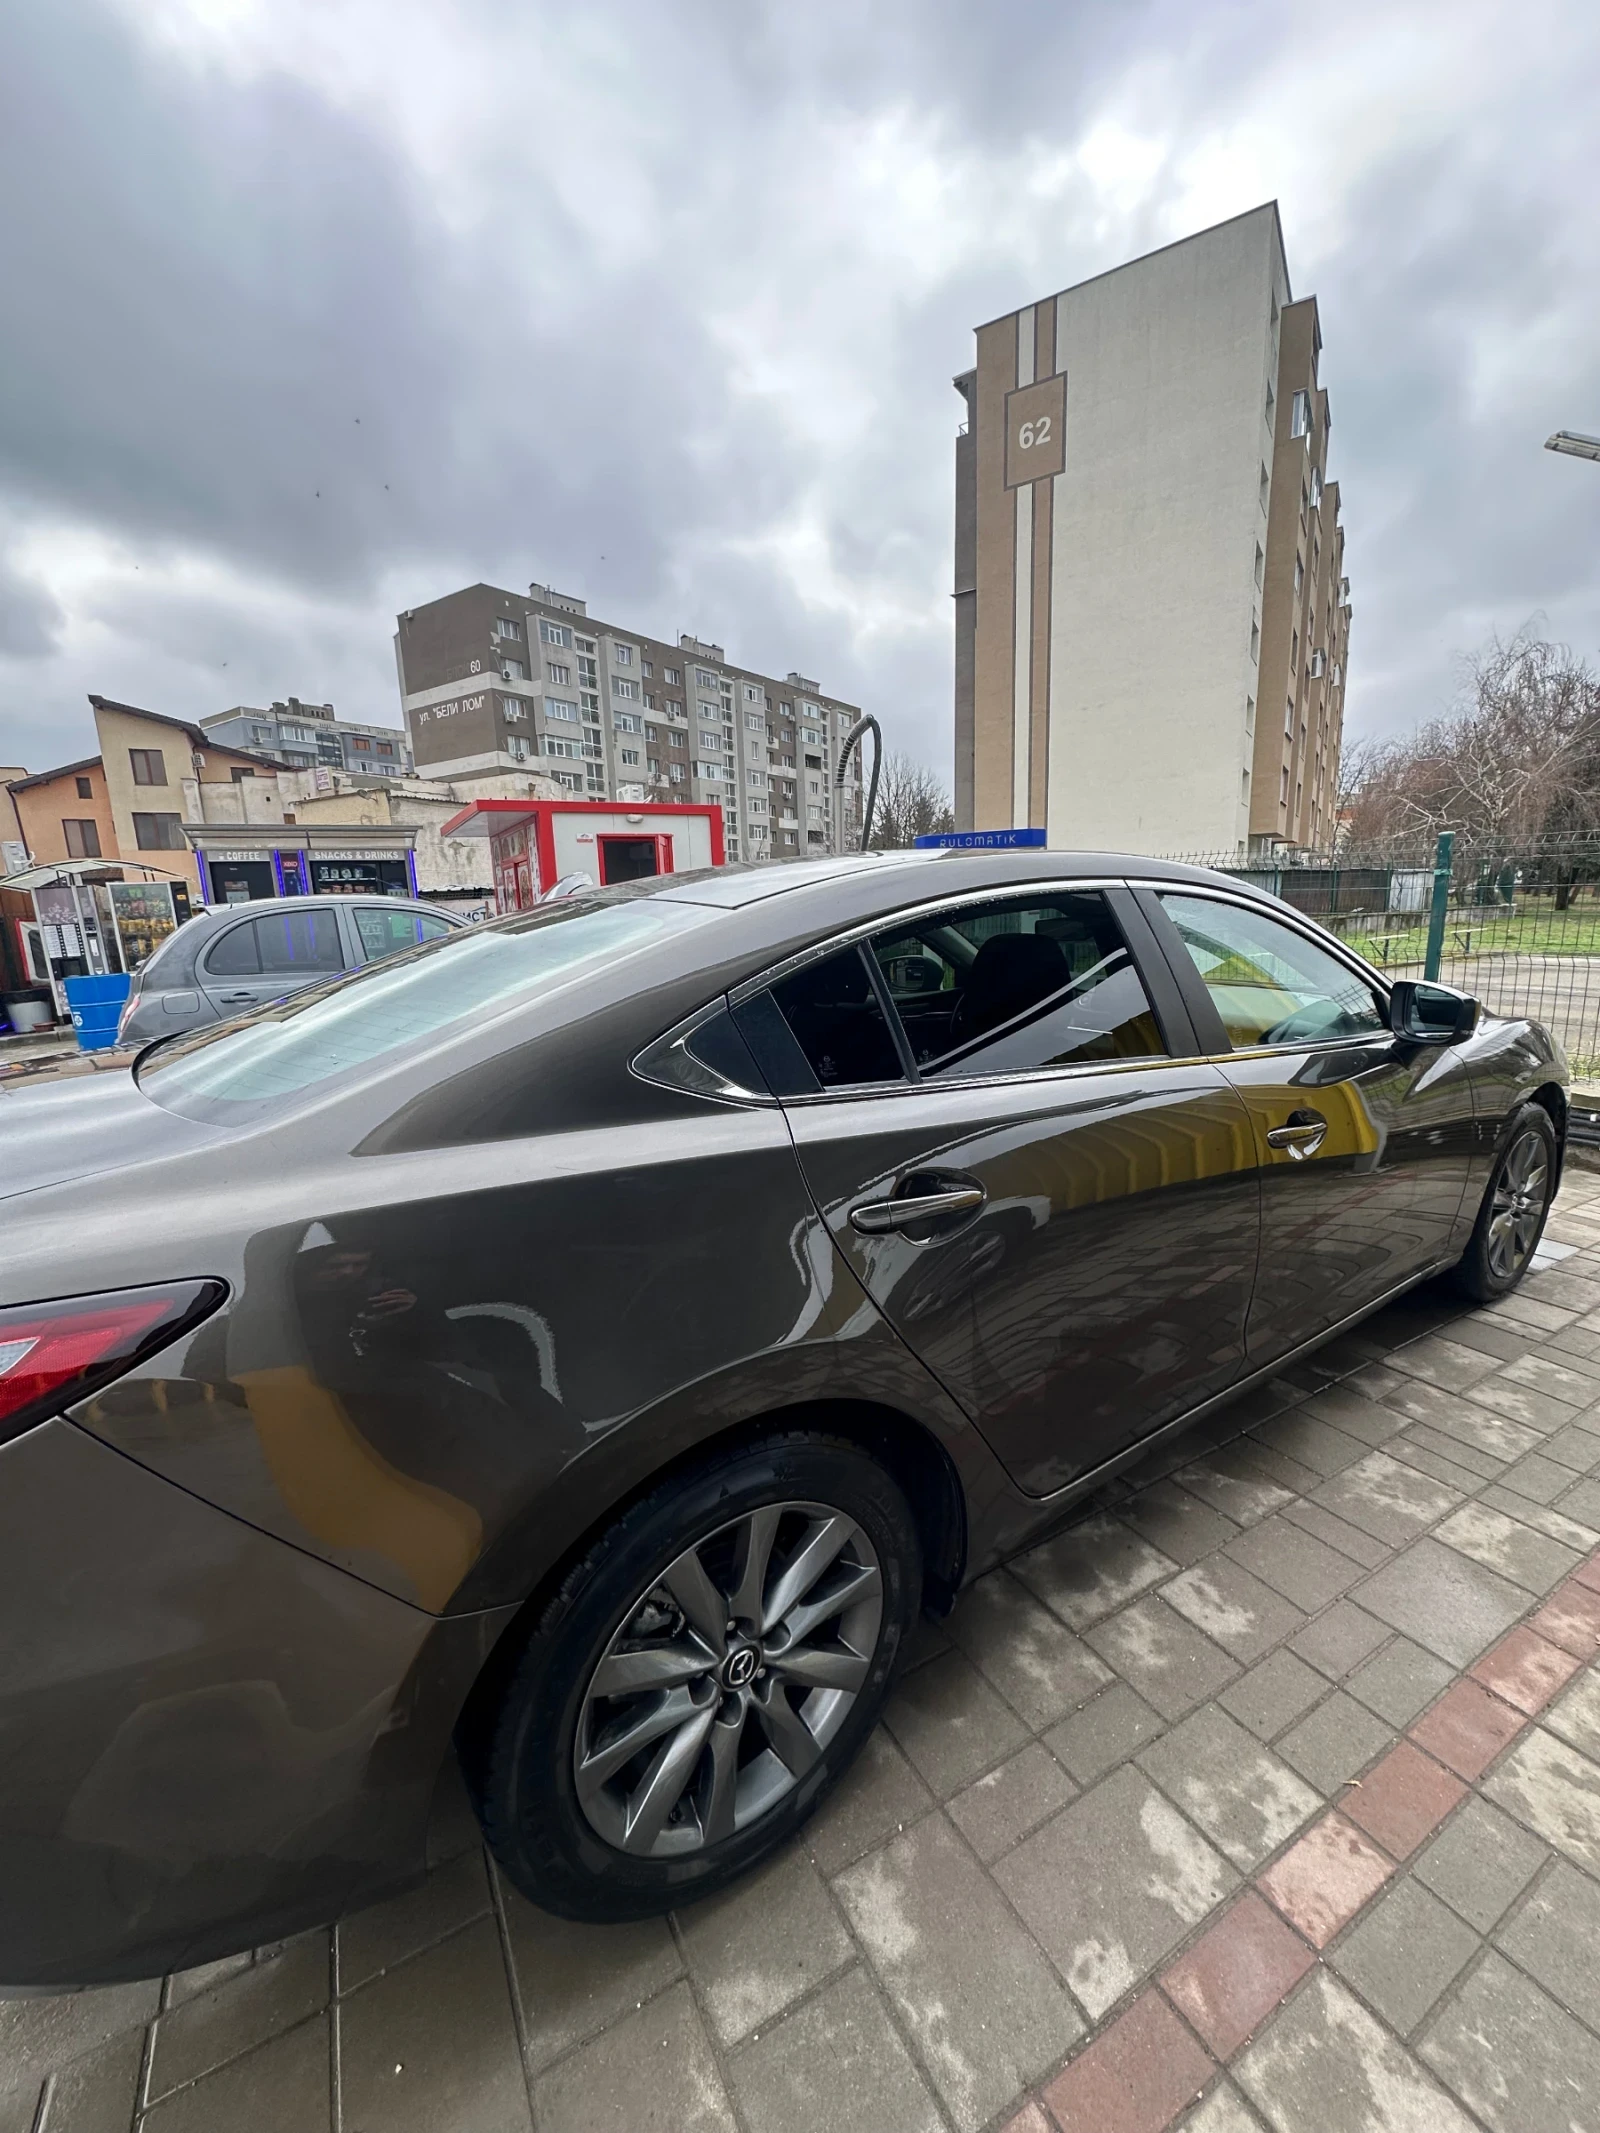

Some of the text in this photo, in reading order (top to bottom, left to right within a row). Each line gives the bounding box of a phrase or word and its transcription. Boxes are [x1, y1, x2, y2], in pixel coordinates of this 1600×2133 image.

[1019, 416, 1051, 449] 62
[470, 659, 481, 673] 60
[226, 851, 260, 860] COFFEE
[314, 851, 399, 860] SNACKS & DRINKS
